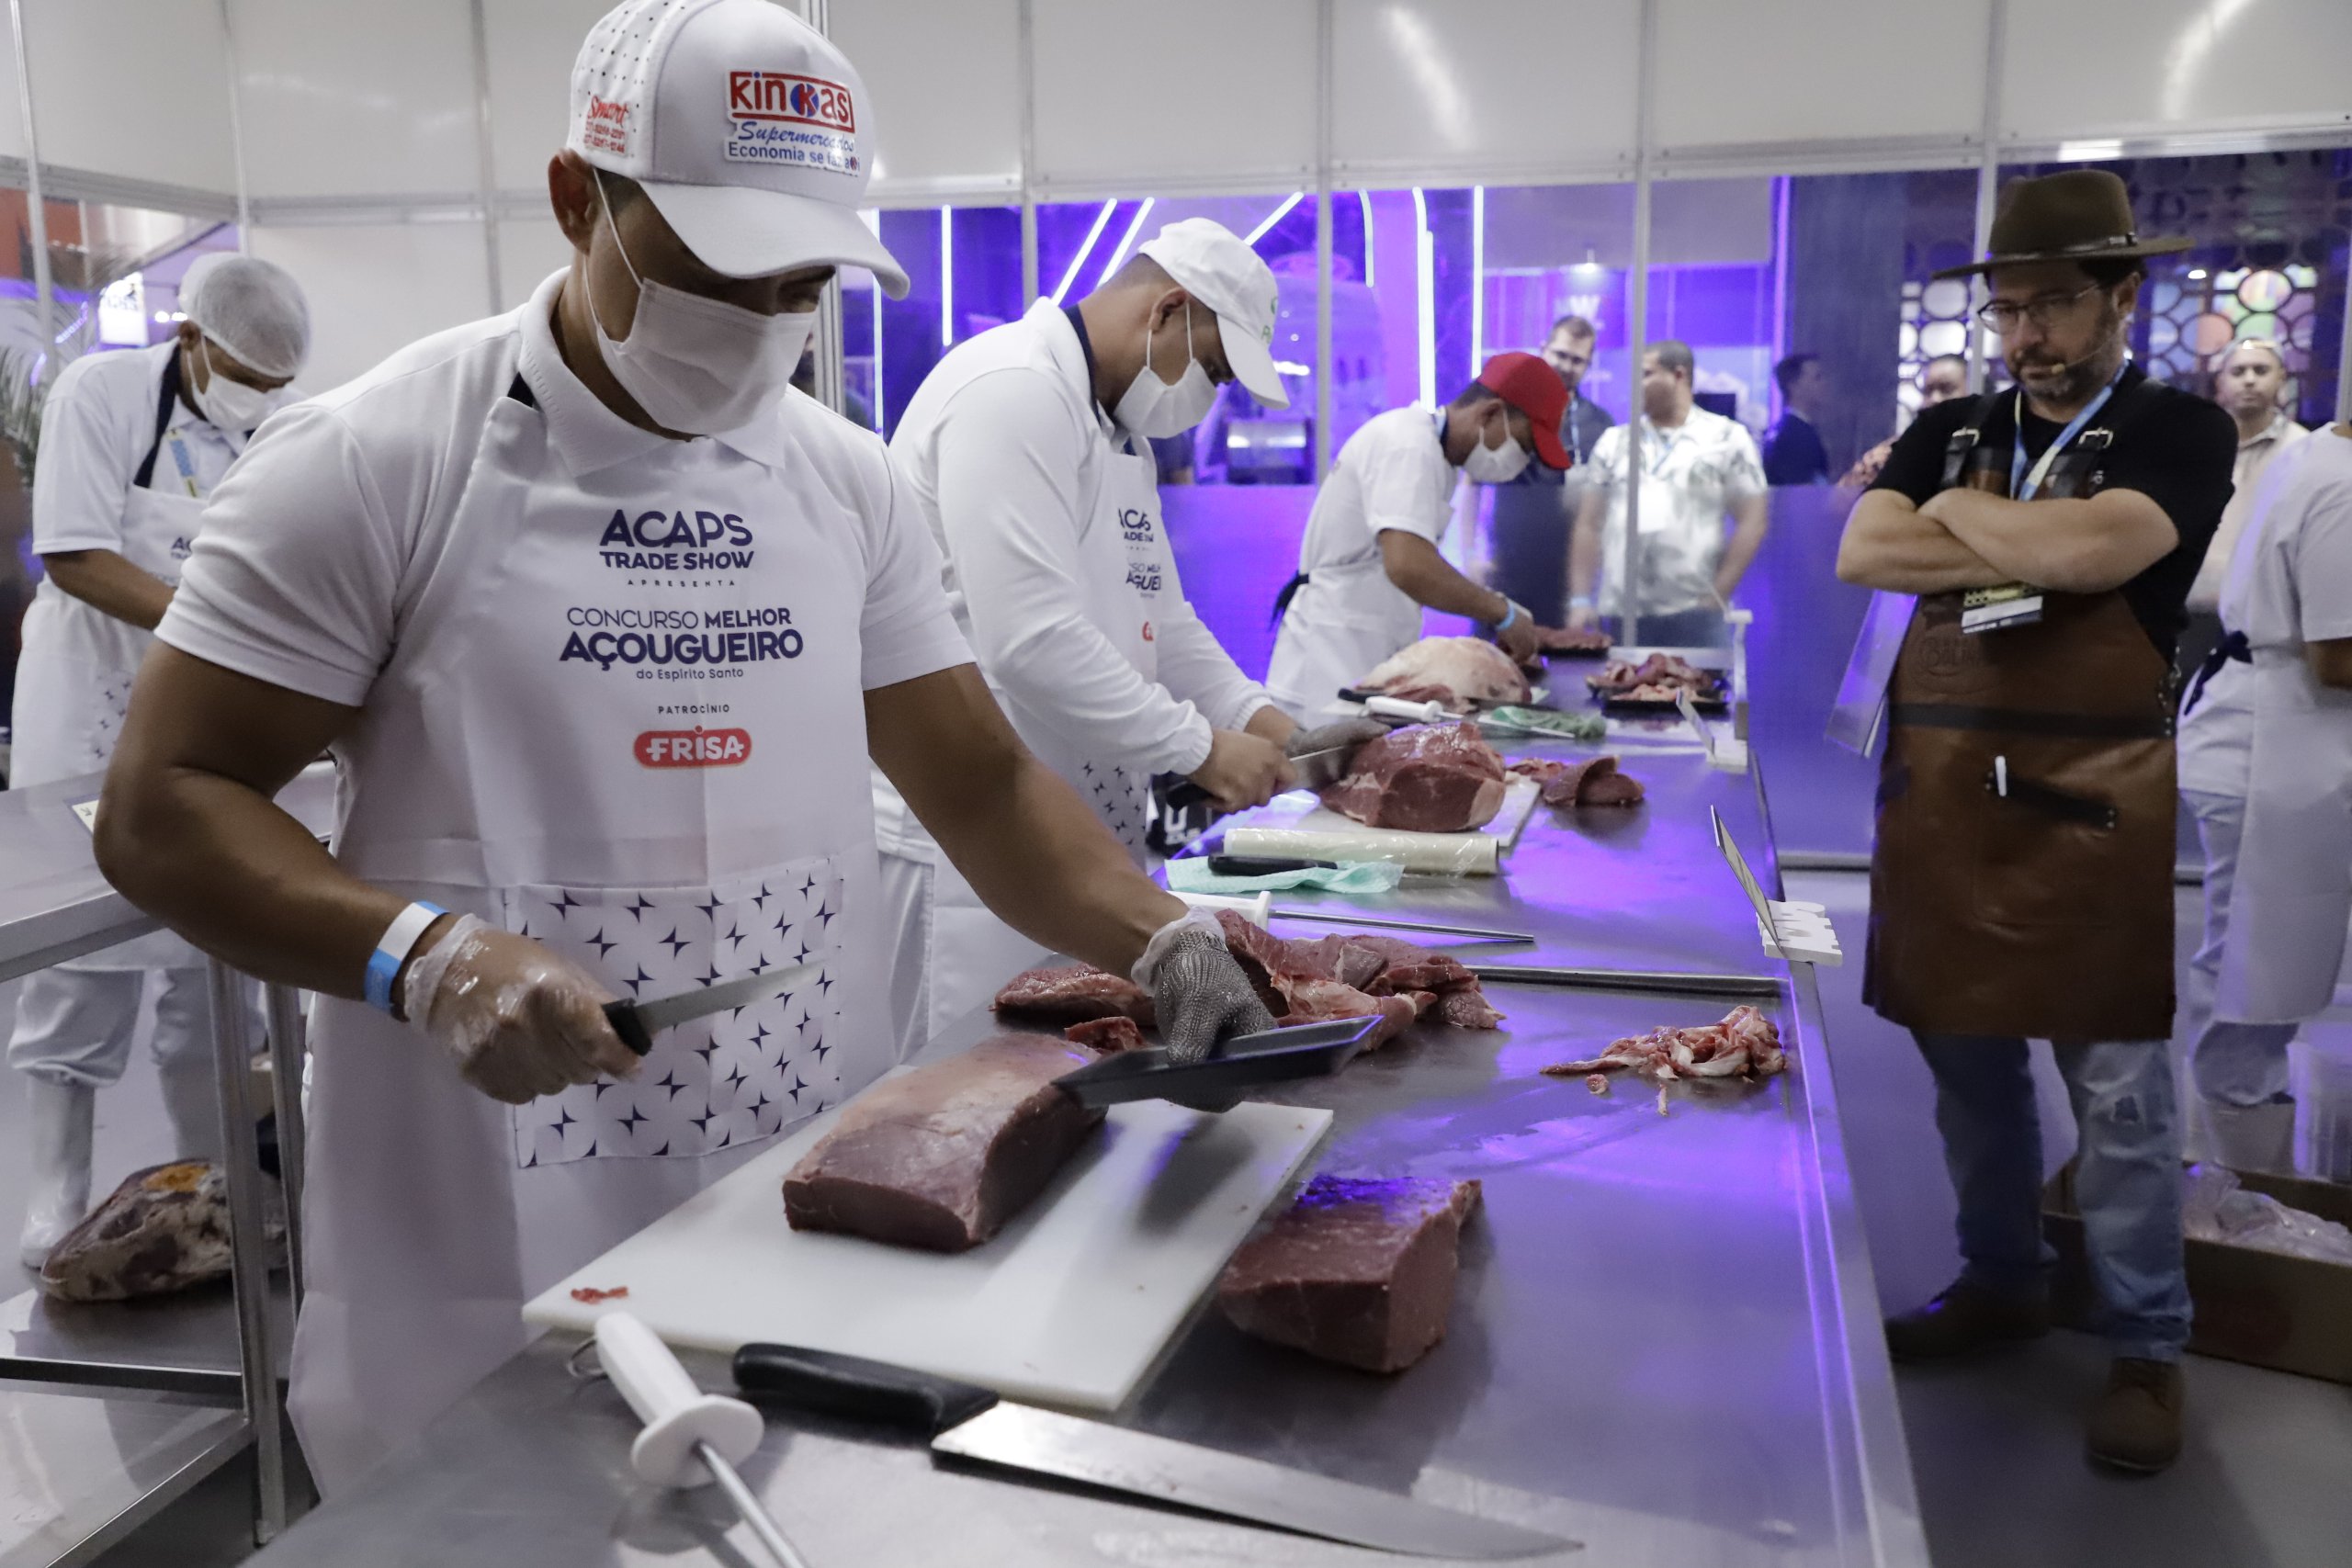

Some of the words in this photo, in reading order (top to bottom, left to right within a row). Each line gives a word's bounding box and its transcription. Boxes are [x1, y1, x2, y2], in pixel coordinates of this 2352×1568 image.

[729, 141, 805, 162] Economia
[809, 152, 824, 164] se
[599, 509, 753, 548] ACAPS
[599, 551, 679, 570] TRADE
[683, 551, 754, 570] SHOW
[567, 607, 699, 629] CONCURSO
[704, 608, 792, 628] MELHOR
[559, 628, 804, 671] AÇOUGUEIRO
[636, 669, 653, 680] do
[709, 668, 744, 680] Santo
[646, 725, 744, 761] FRISA
